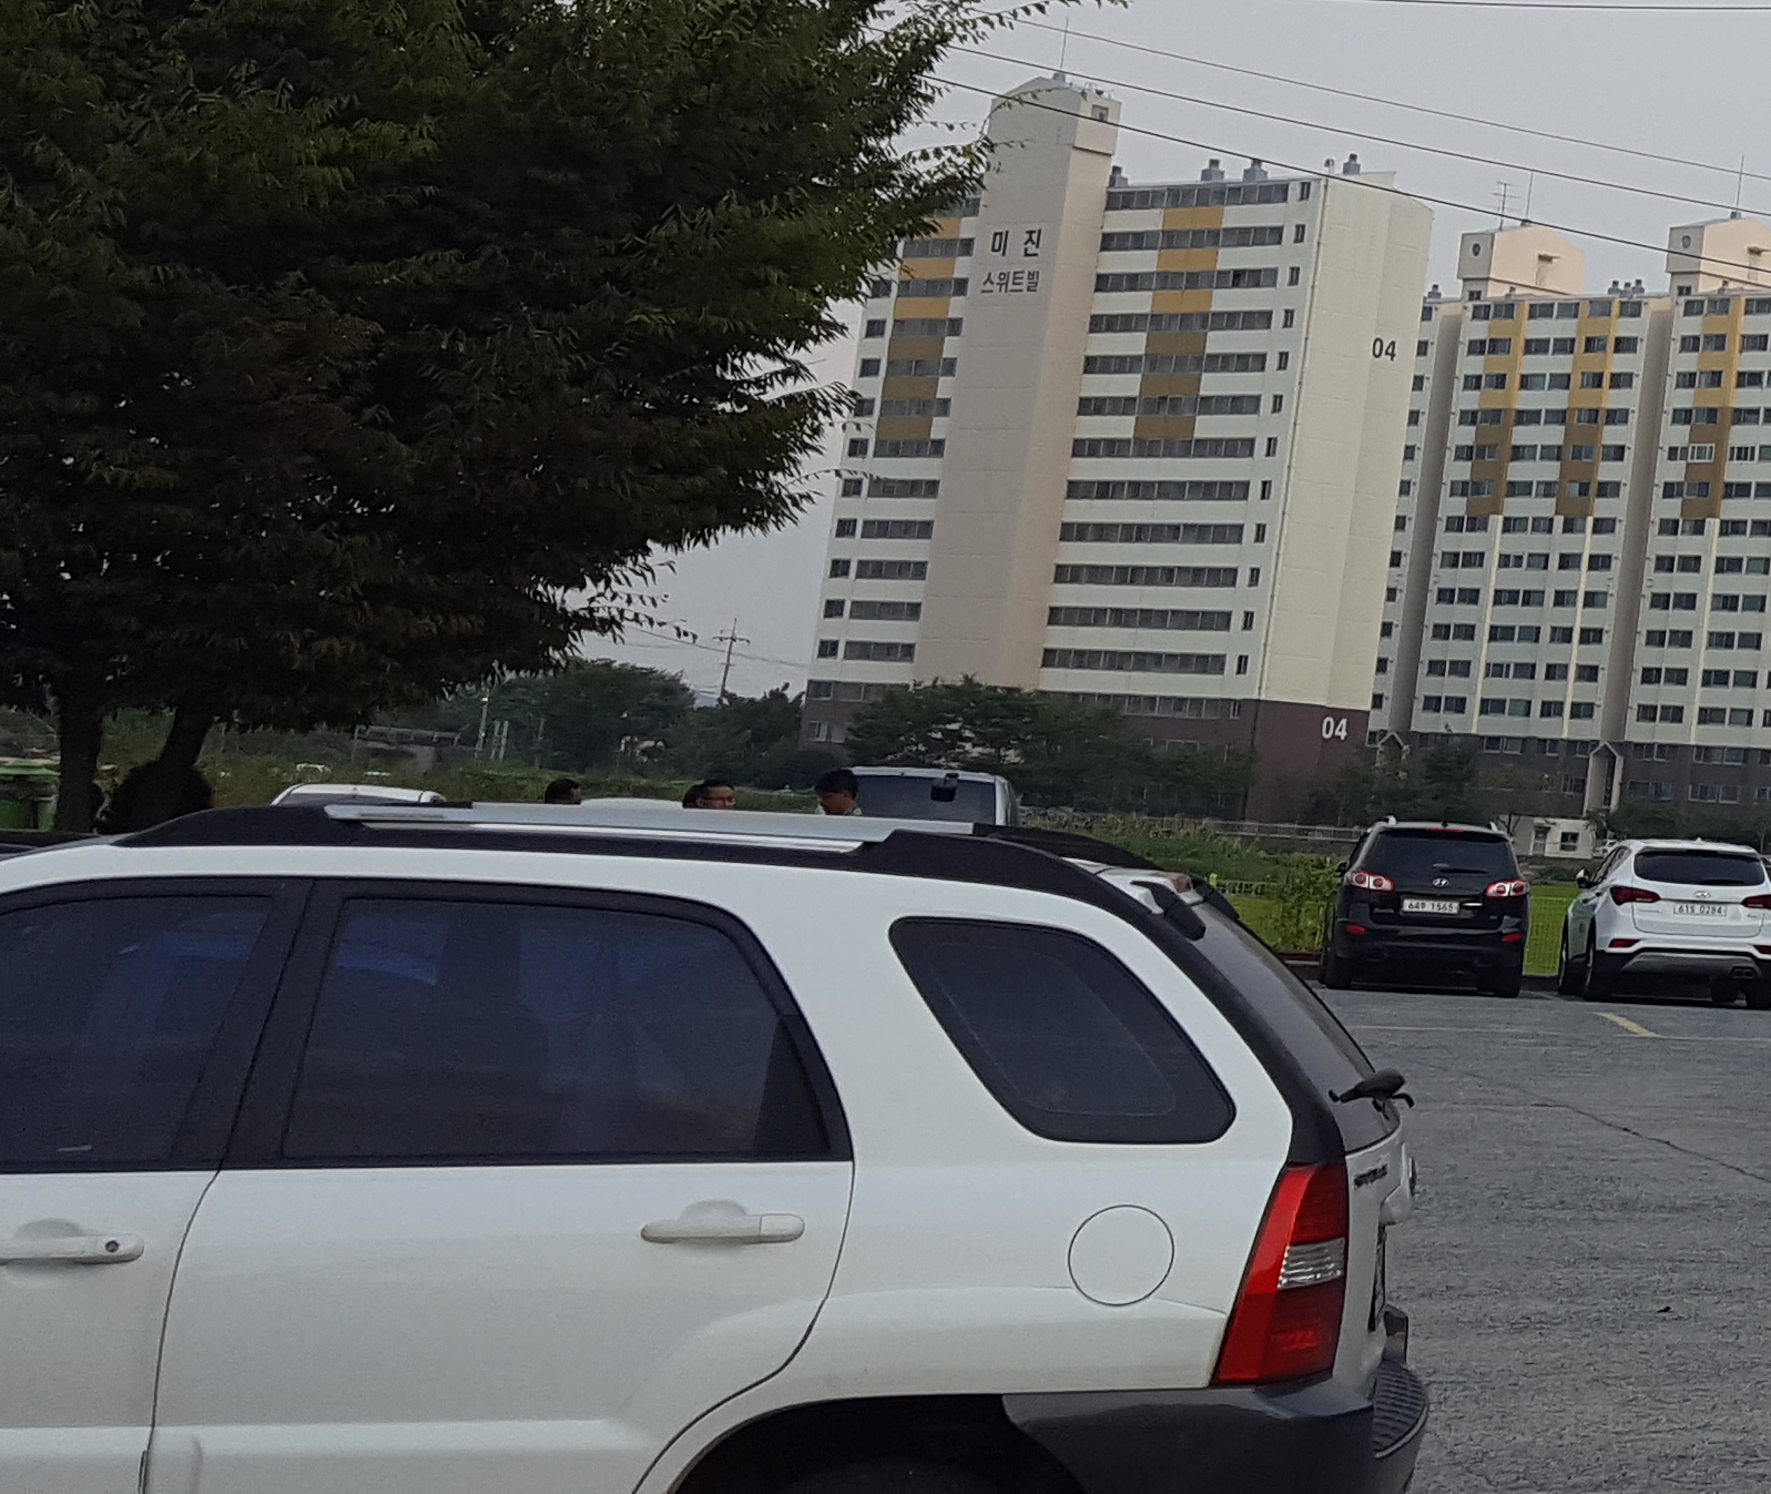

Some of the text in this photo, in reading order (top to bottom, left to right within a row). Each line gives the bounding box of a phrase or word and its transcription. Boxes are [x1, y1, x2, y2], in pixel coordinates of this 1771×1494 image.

[981, 270, 1040, 294] 스위트빌
[1372, 337, 1397, 362] 04
[1322, 716, 1348, 741] 04
